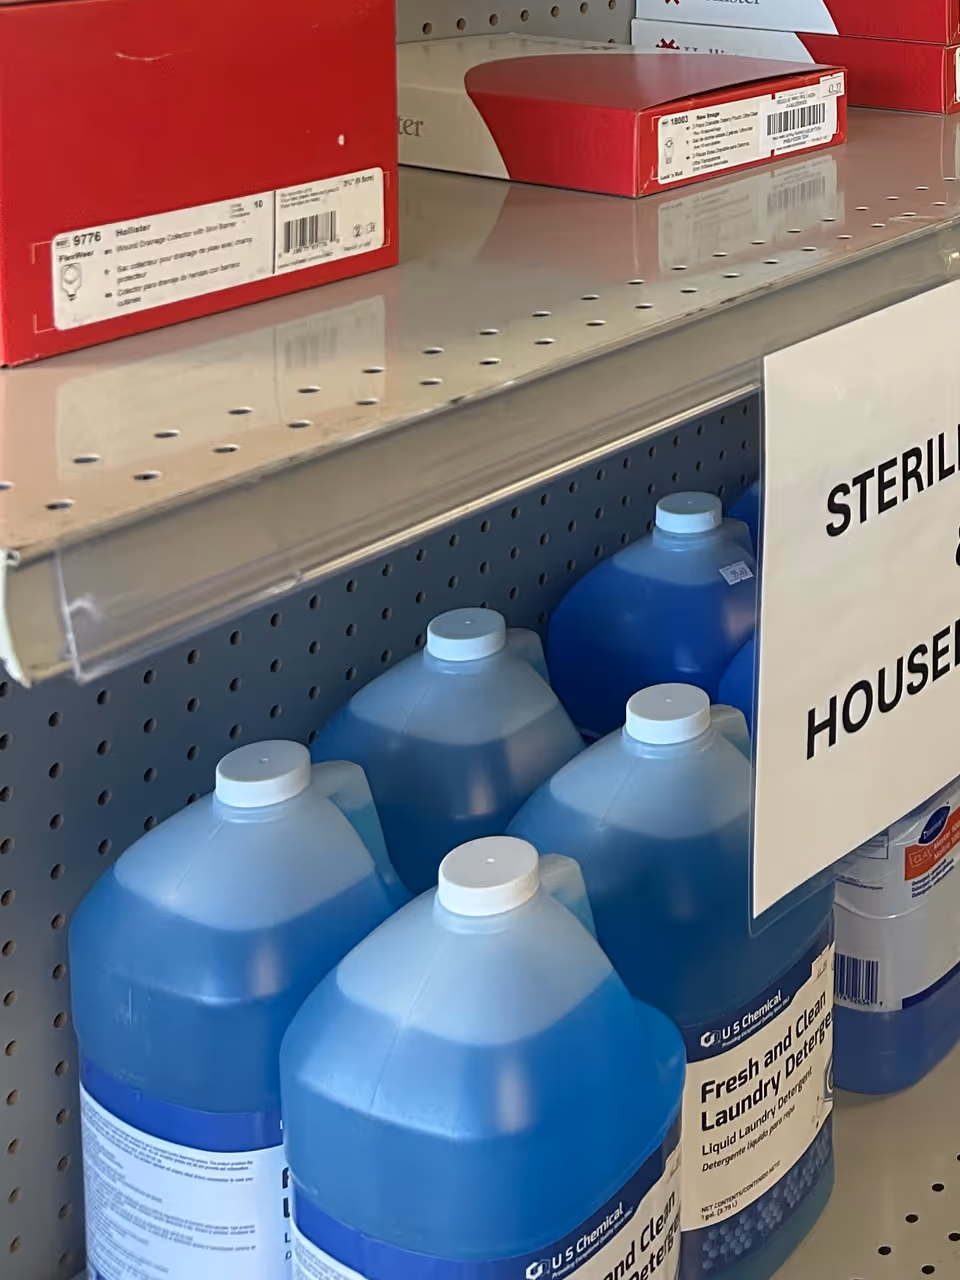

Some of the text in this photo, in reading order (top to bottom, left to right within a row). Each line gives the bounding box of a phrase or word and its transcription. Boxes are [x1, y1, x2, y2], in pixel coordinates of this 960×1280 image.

[73, 231, 102, 246] 9776
[116, 225, 151, 236] Hollister
[722, 990, 781, 1039] U S Chemical
[701, 991, 826, 1103] Fresh and Clean
[701, 1070, 781, 1131] Laundry
[702, 1066, 812, 1156] Liquid Laundry Detergent
[702, 1147, 746, 1172] Detergente
[769, 1117, 782, 1136] para
[783, 1104, 796, 1122] ropa
[552, 1202, 623, 1269] U S Chemical
[641, 1190, 675, 1252] Clean
[701, 1204, 714, 1213] NET
